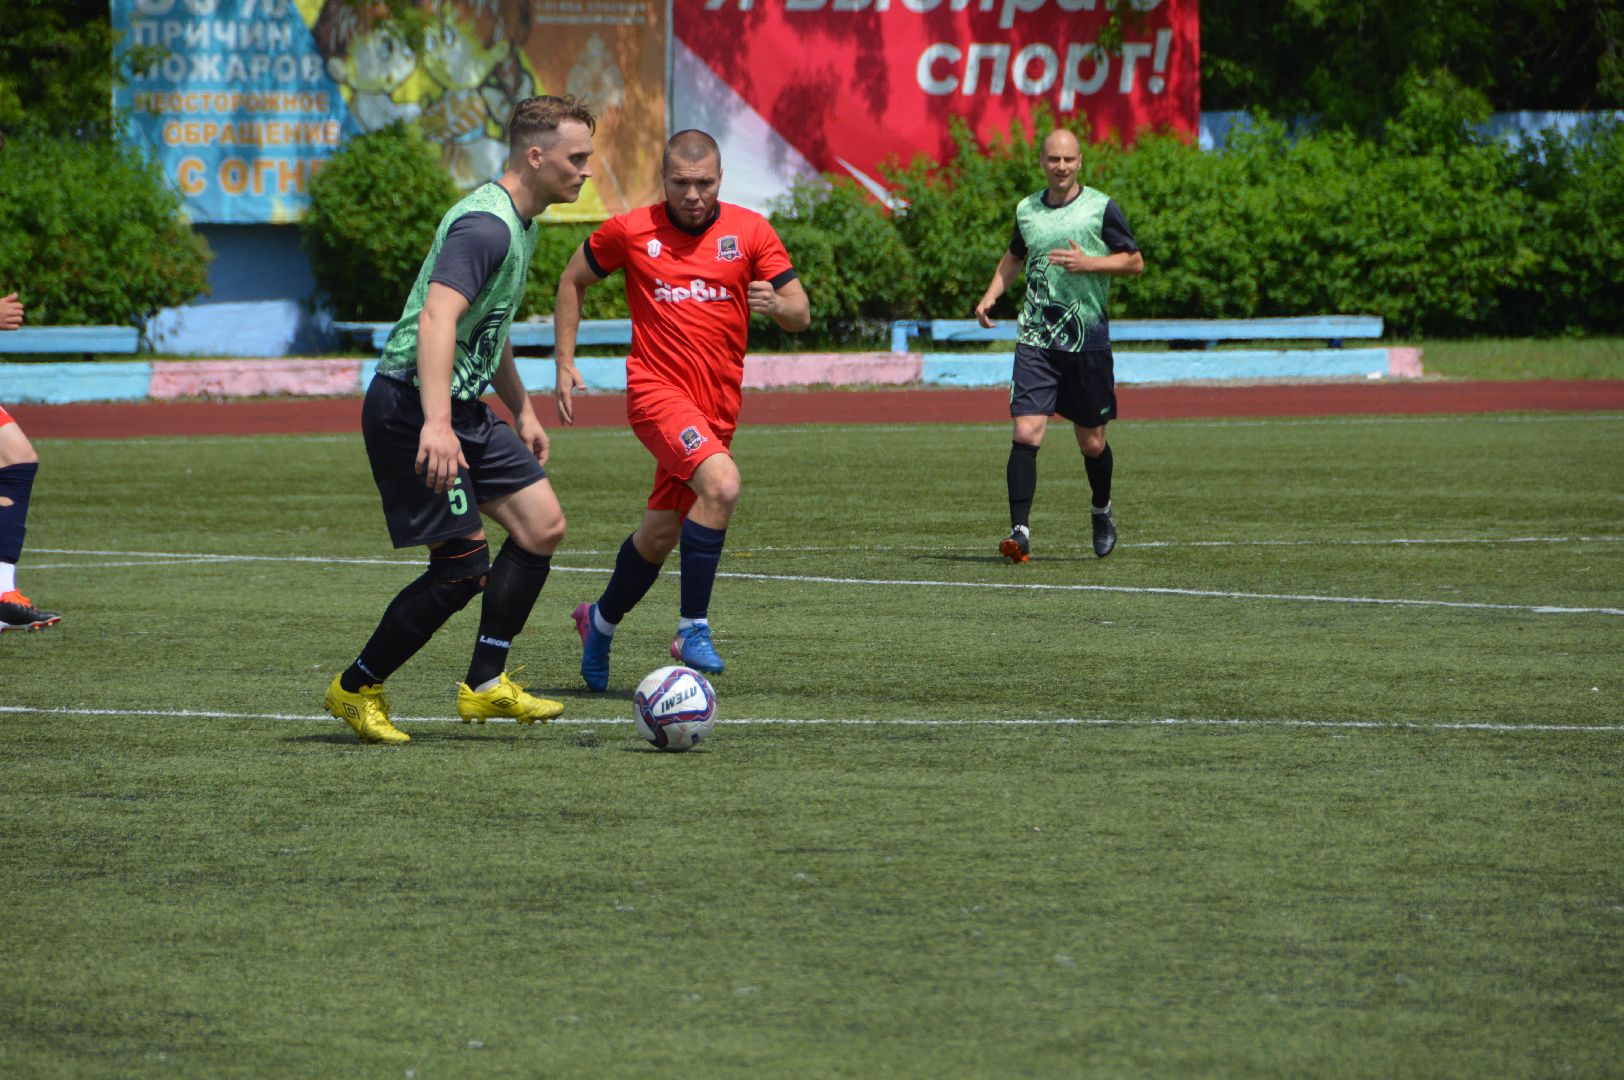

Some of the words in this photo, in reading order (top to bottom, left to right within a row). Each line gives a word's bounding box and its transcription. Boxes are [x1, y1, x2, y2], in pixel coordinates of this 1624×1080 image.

[134, 20, 293, 49] ПРИЧИН
[916, 28, 1172, 111] спорт!
[134, 90, 331, 114] НЕОСТОРОЖНОЕ
[163, 120, 341, 148] ОБРАЩЕНИЕ
[177, 157, 207, 195] С
[219, 157, 324, 195] ОГН
[448, 477, 467, 515] 5
[661, 685, 697, 713] ATEMI
